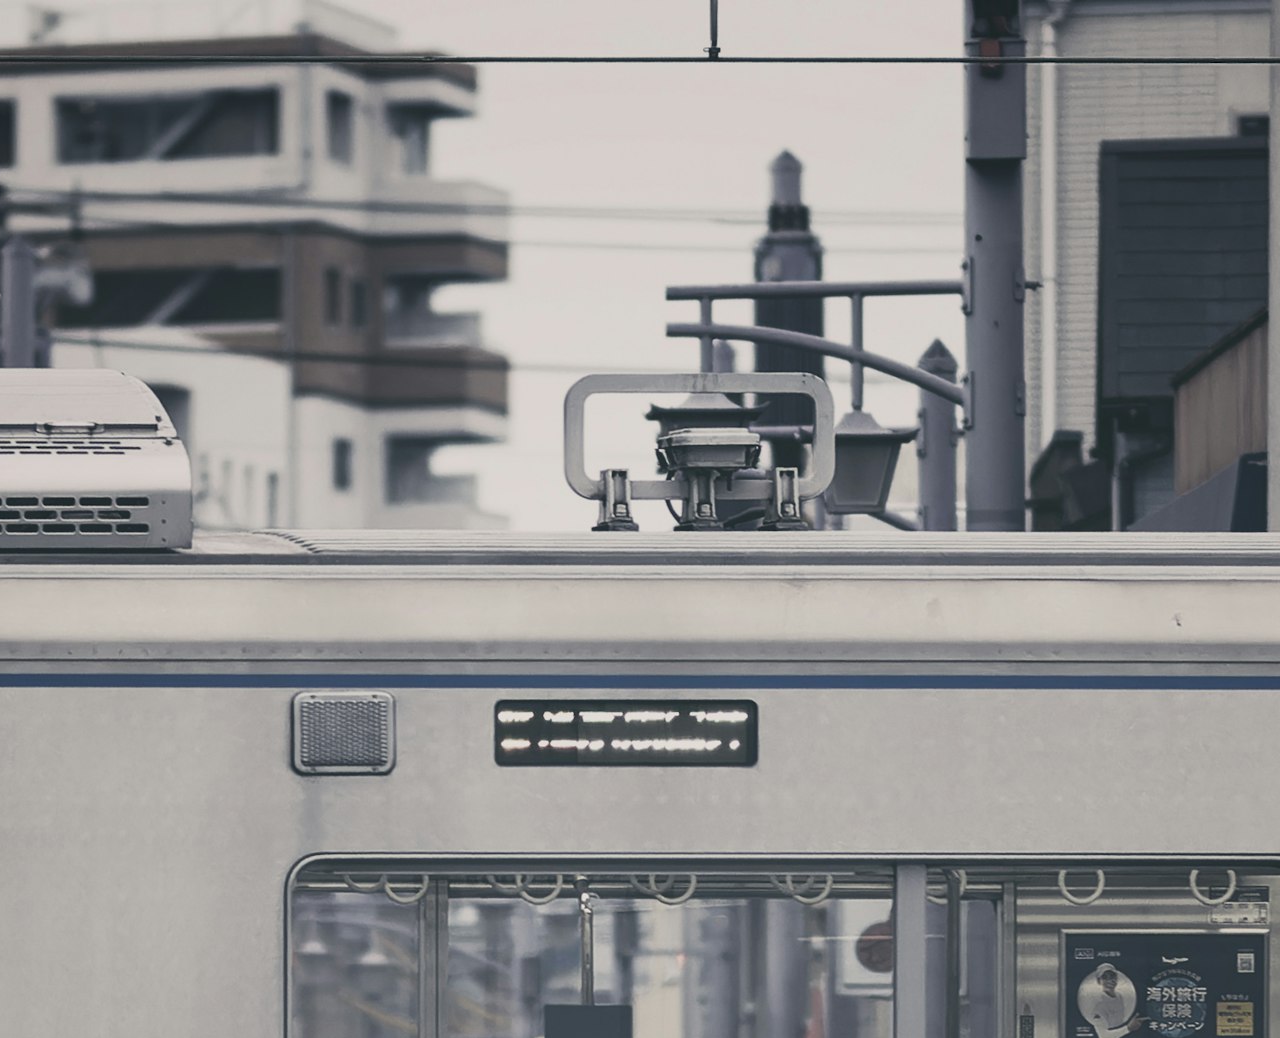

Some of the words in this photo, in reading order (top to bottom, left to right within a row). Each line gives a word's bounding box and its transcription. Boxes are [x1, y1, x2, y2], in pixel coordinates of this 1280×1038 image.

[1147, 987, 1207, 1002] 海外旅行
[1162, 1003, 1192, 1018] 保険
[1149, 1021, 1205, 1031] キャンペーン
